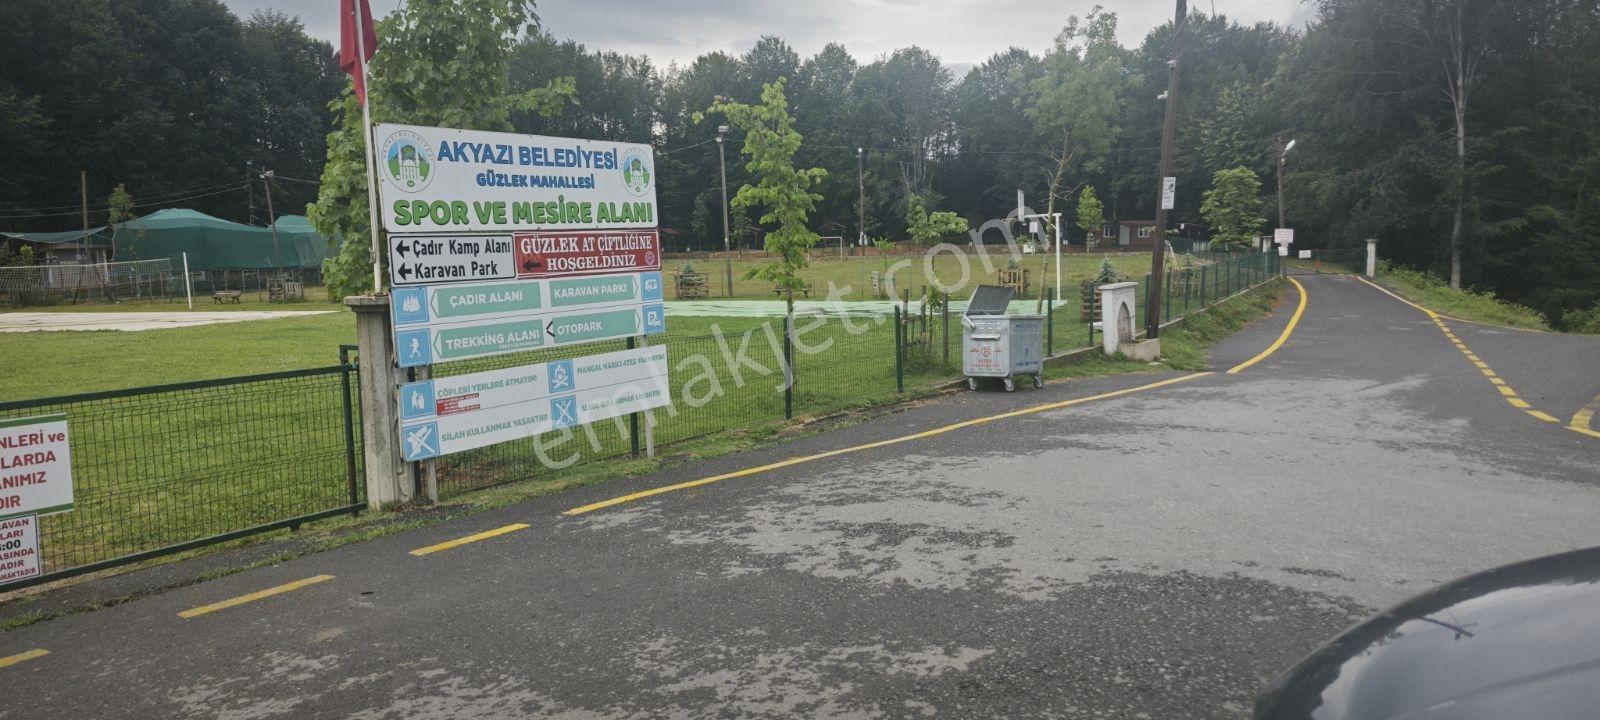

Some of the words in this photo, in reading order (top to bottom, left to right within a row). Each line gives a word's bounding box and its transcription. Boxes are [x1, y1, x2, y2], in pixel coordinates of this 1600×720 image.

[437, 140, 513, 165] AKYAZI
[519, 145, 619, 170] BELEDİYESİ
[476, 169, 528, 187] GÜZLEK
[530, 173, 595, 189] MAHALLESİ
[393, 199, 469, 226] SPOR
[474, 200, 507, 225] VE
[513, 195, 592, 225] MESİRE
[597, 200, 653, 223] ALANI
[413, 239, 443, 258] Çadır
[449, 239, 480, 257] Kamp
[485, 239, 510, 254] Alanı
[520, 235, 579, 254] GÜZLEK
[582, 237, 595, 252] AT
[598, 233, 652, 255] ÇİFTLİĞİNE
[414, 262, 466, 279] Karavan
[471, 260, 498, 276] Park
[546, 251, 636, 271] HOŞGELDİNİZ
[449, 293, 486, 309] ÇADIR
[489, 291, 523, 303] ALANI
[554, 286, 599, 299] KARAVAN
[600, 283, 627, 294] PARKI
[557, 321, 602, 335] OTOPARK
[446, 333, 505, 350] TREKKİNG
[507, 329, 540, 343] ALANI
[437, 384, 471, 399] ÇÖPLERİ
[472, 380, 505, 392] YERLERE
[48, 432, 66, 443] ve
[441, 430, 466, 442] SİLAH
[466, 421, 512, 437] KULLANMAK
[0, 450, 57, 470] LARDA
[0, 471, 47, 490] NIMIZ
[0, 518, 29, 530] AVAN
